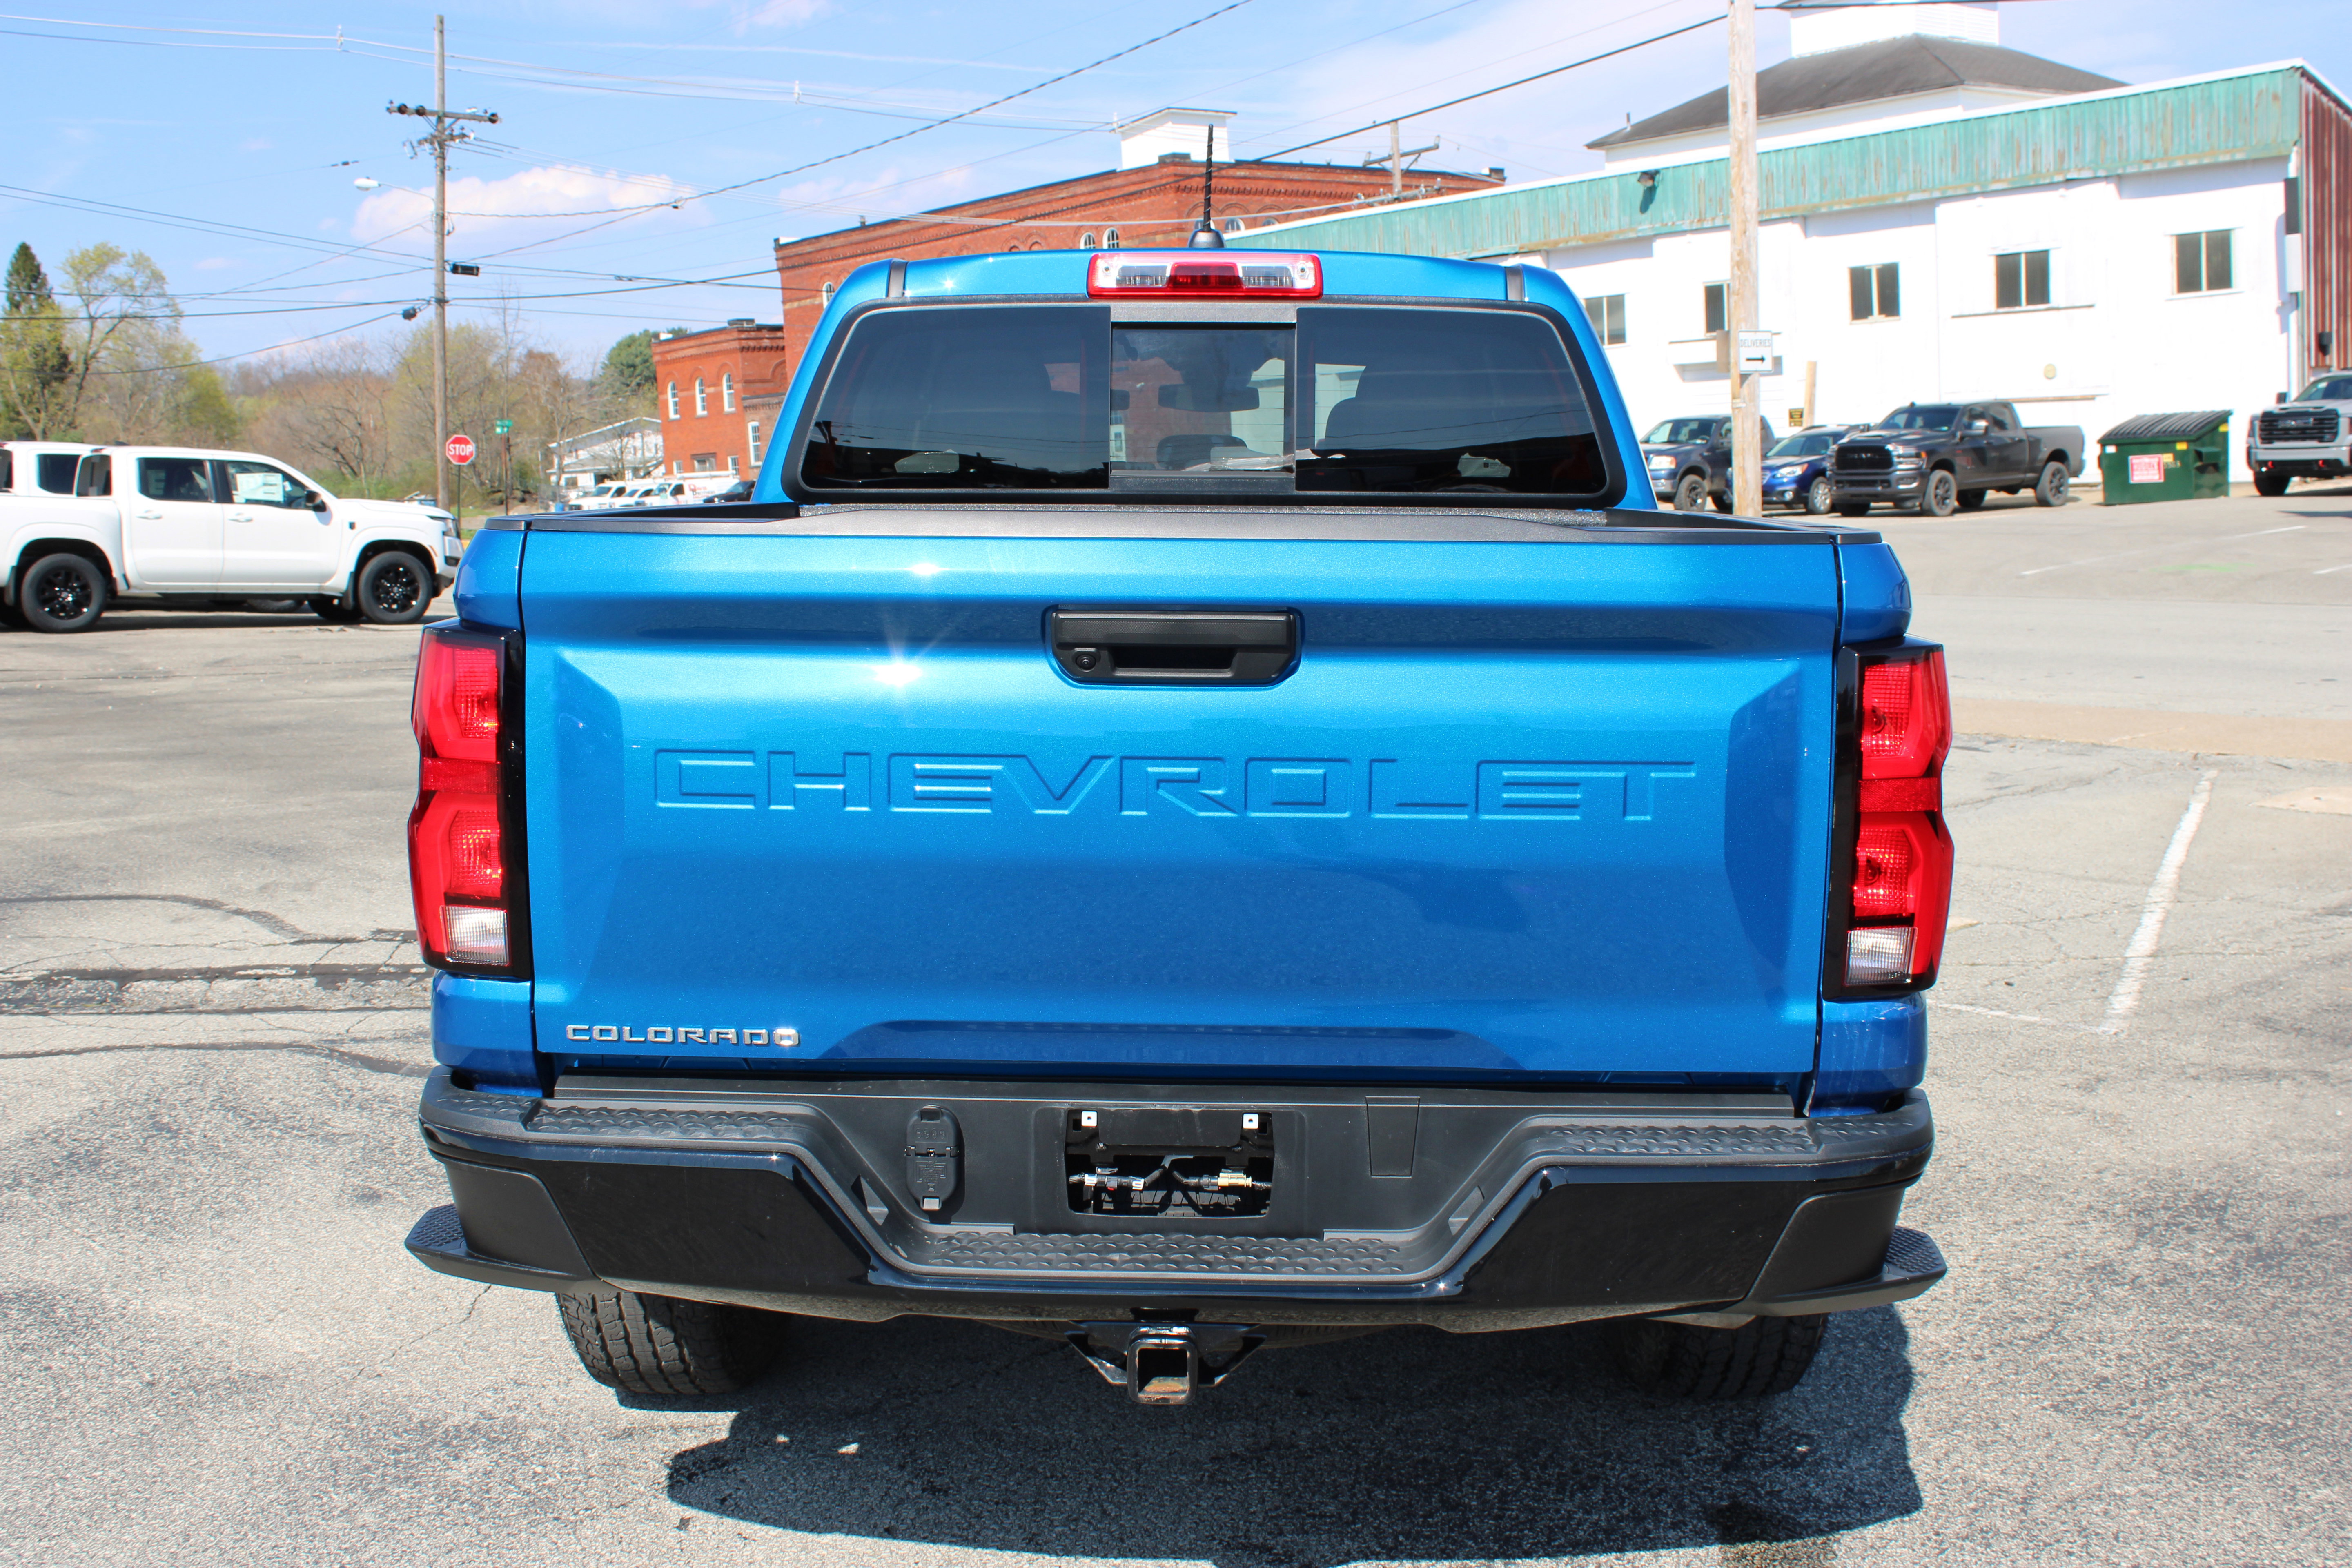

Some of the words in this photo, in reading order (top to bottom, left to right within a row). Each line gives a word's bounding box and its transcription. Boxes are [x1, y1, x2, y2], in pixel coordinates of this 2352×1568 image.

[1740, 339, 1771, 347] DELIVERIES
[449, 444, 472, 455] STOP
[655, 750, 1695, 821] CHEVROLET
[566, 1025, 799, 1045] COLORADO
